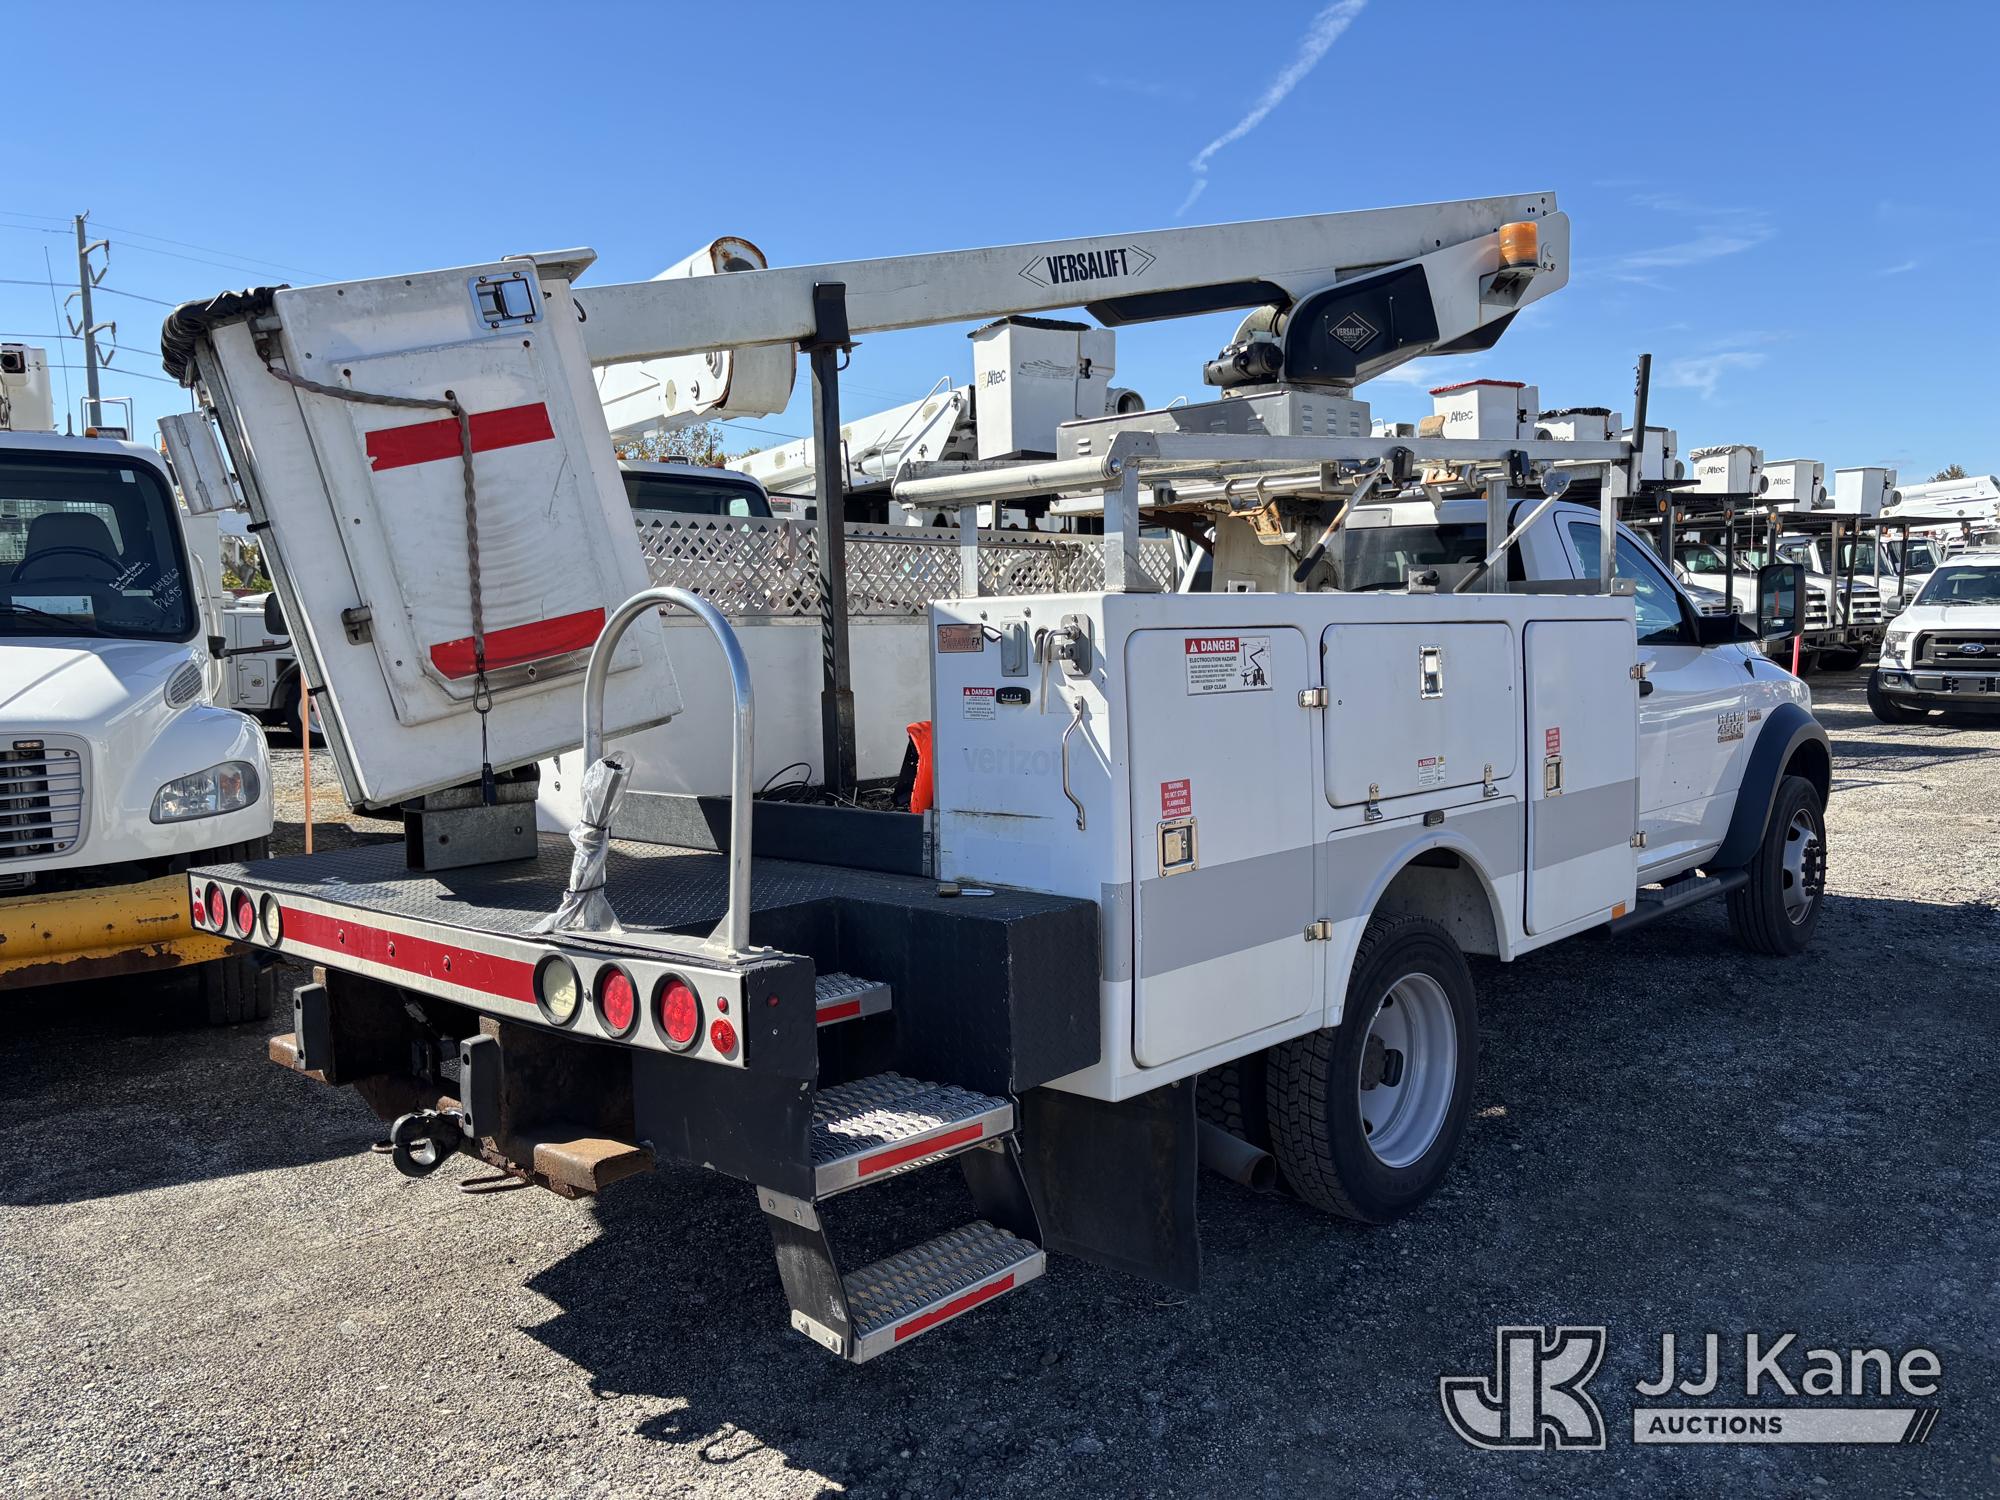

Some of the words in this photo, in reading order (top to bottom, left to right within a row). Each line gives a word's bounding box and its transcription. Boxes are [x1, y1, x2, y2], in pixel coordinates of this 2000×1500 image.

[1046, 248, 1128, 284] VERSALIFT
[1336, 327, 1365, 336] VERSALIFT
[987, 369, 1006, 387] Altec
[1450, 410, 1473, 423] Altec
[1706, 466, 1726, 474] Altec
[1773, 478, 1791, 486] Altec
[1200, 639, 1236, 652] DANGER
[971, 688, 994, 696] DANGER
